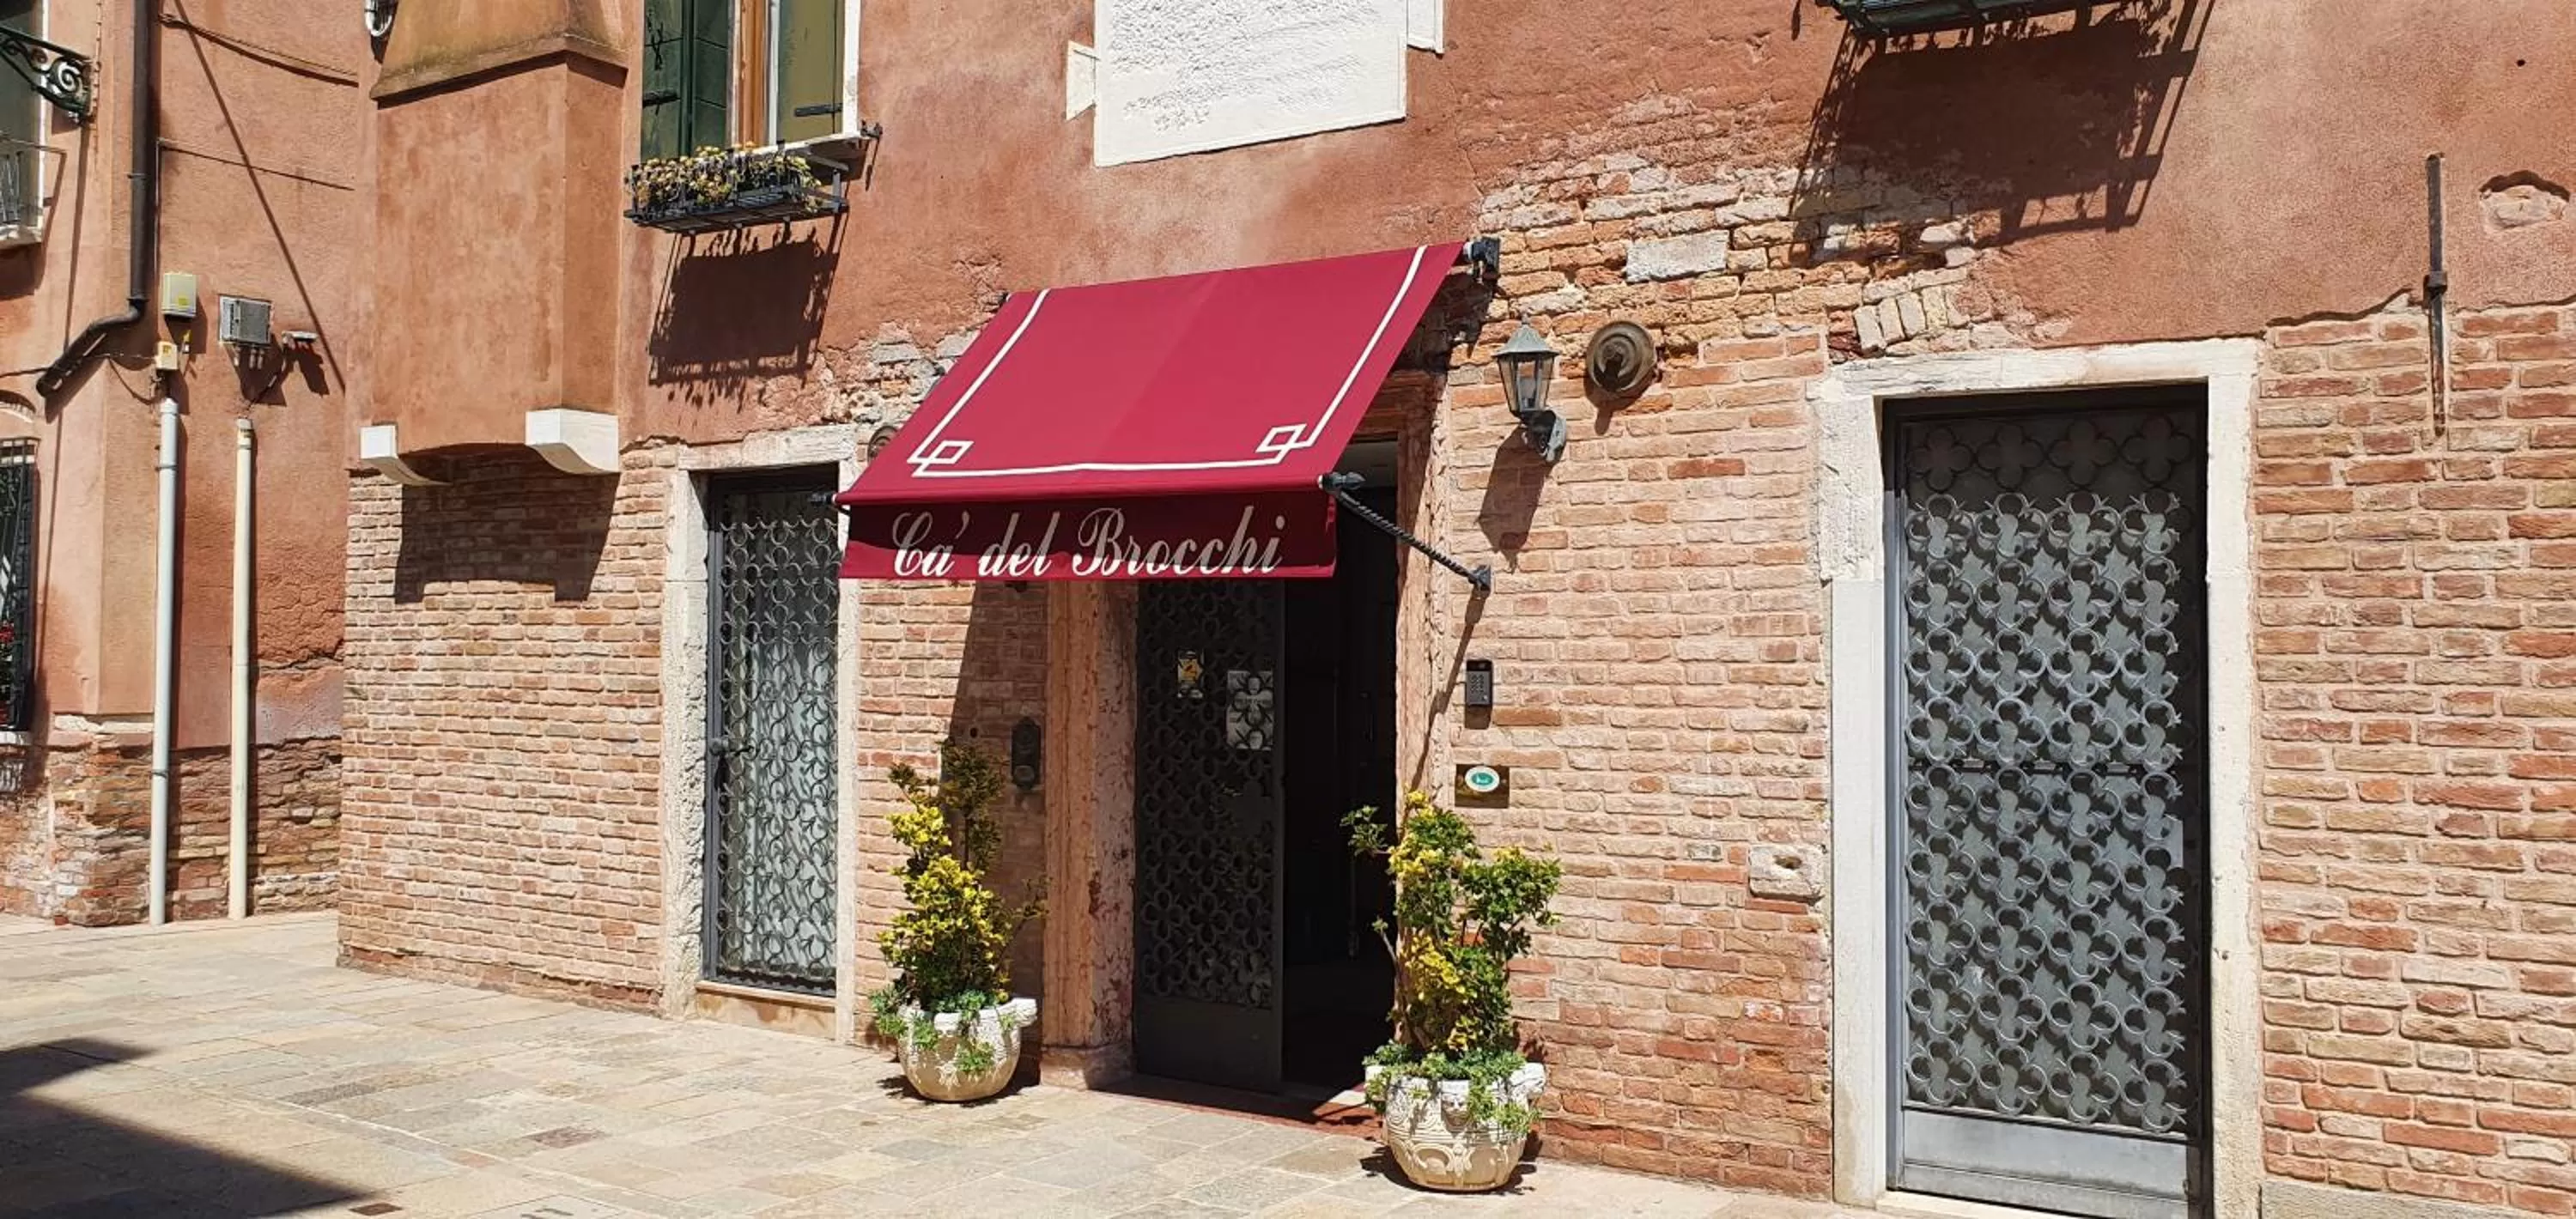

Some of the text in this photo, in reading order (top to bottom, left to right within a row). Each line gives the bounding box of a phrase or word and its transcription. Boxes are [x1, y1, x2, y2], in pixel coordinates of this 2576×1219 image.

[891, 505, 1285, 578] Ca' del Brocchi
